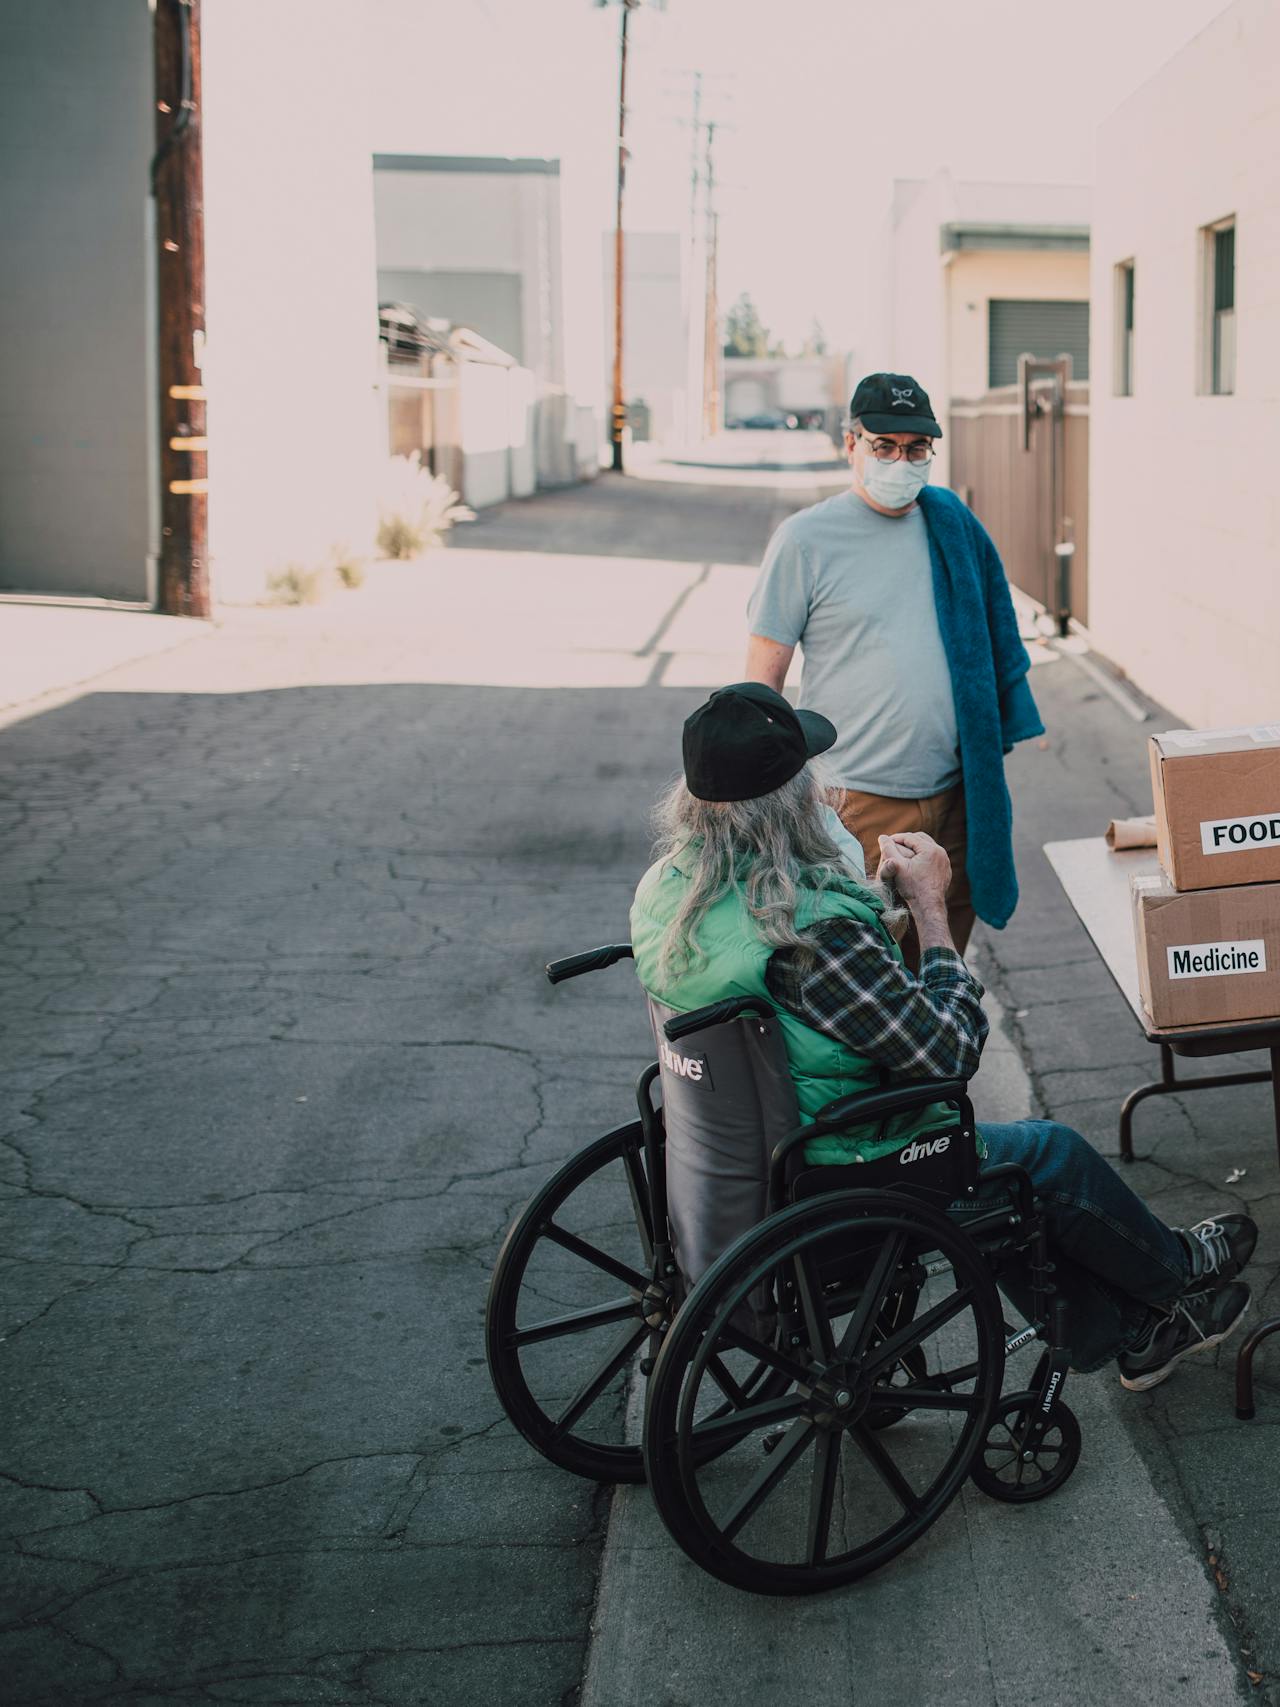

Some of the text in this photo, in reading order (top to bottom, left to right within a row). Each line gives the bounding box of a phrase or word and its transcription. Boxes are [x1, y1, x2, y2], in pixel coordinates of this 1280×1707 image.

[1173, 947, 1259, 974] Medicine
[900, 1136, 951, 1165] drive
[1041, 1371, 1062, 1413] Cirrus IV
